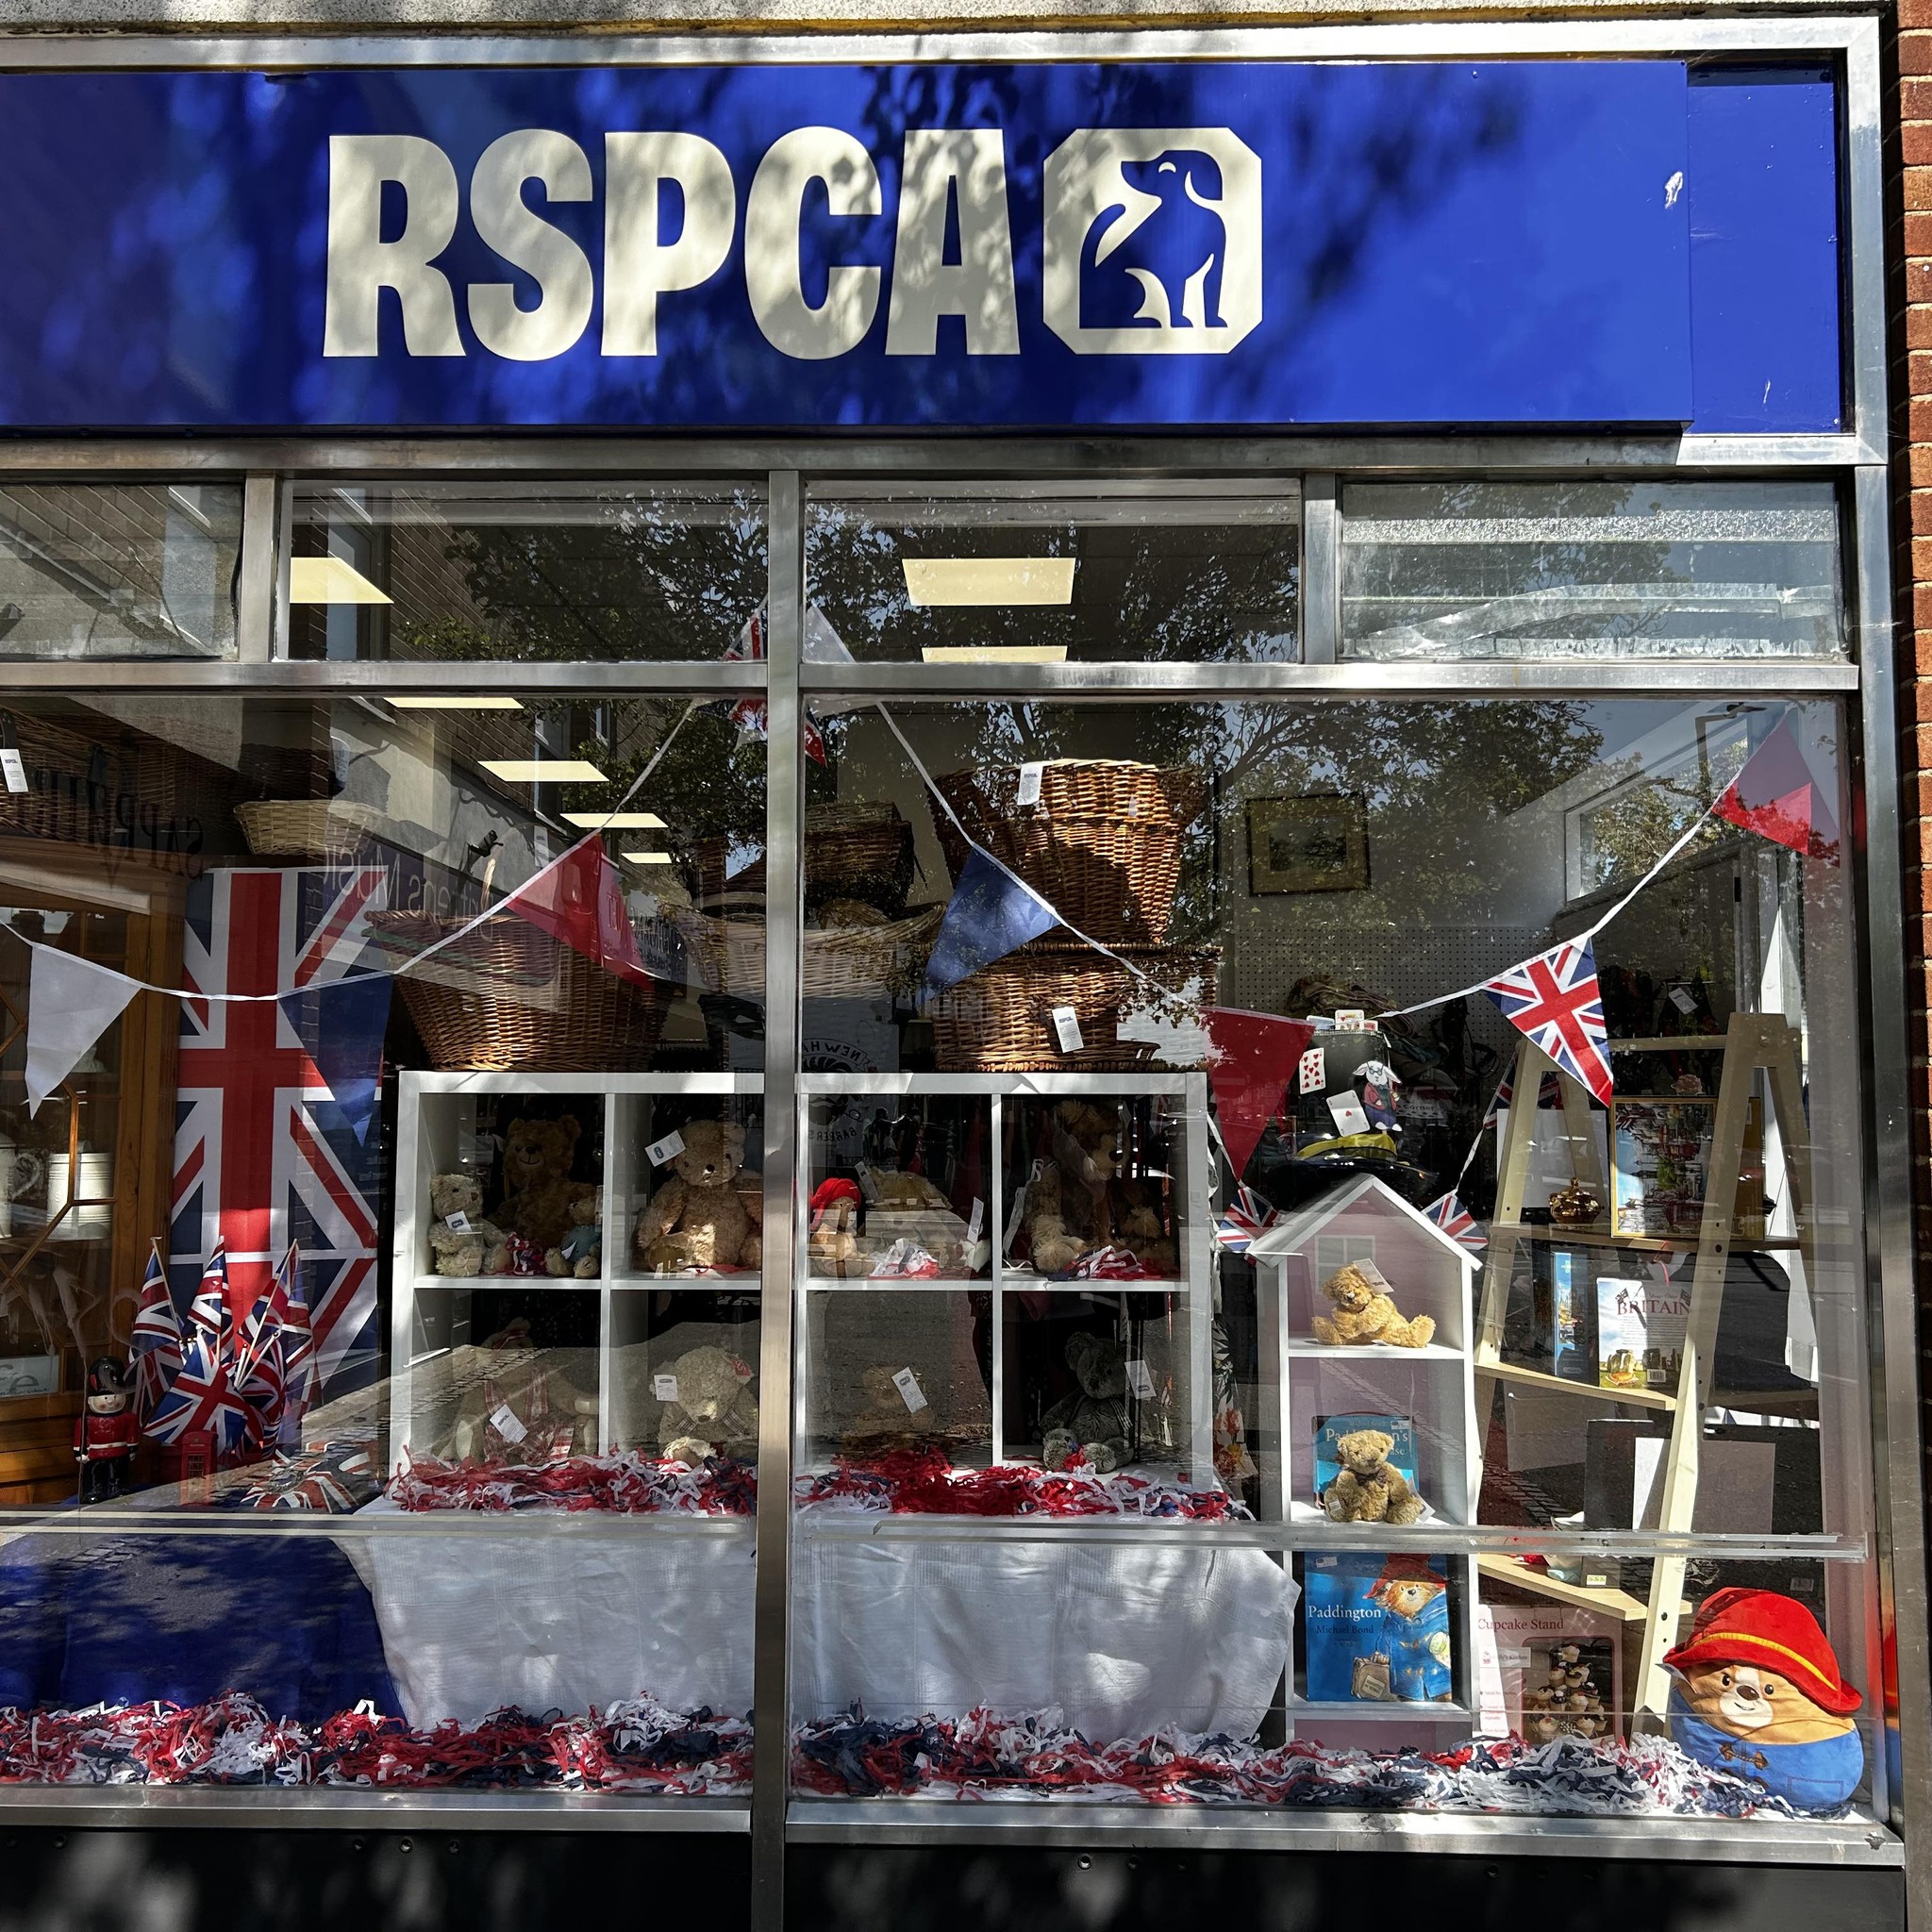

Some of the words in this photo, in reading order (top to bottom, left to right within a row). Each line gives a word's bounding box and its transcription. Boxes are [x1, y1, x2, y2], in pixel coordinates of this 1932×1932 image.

[323, 125, 1021, 361] RSPCA
[1617, 1299, 1690, 1315] BRITAIN
[1307, 1605, 1381, 1622] Paddington
[1316, 1624, 1349, 1634] Michael
[1352, 1624, 1374, 1634] Bond
[1477, 1618, 1528, 1633] Cupcake
[1530, 1618, 1564, 1630] Stand
